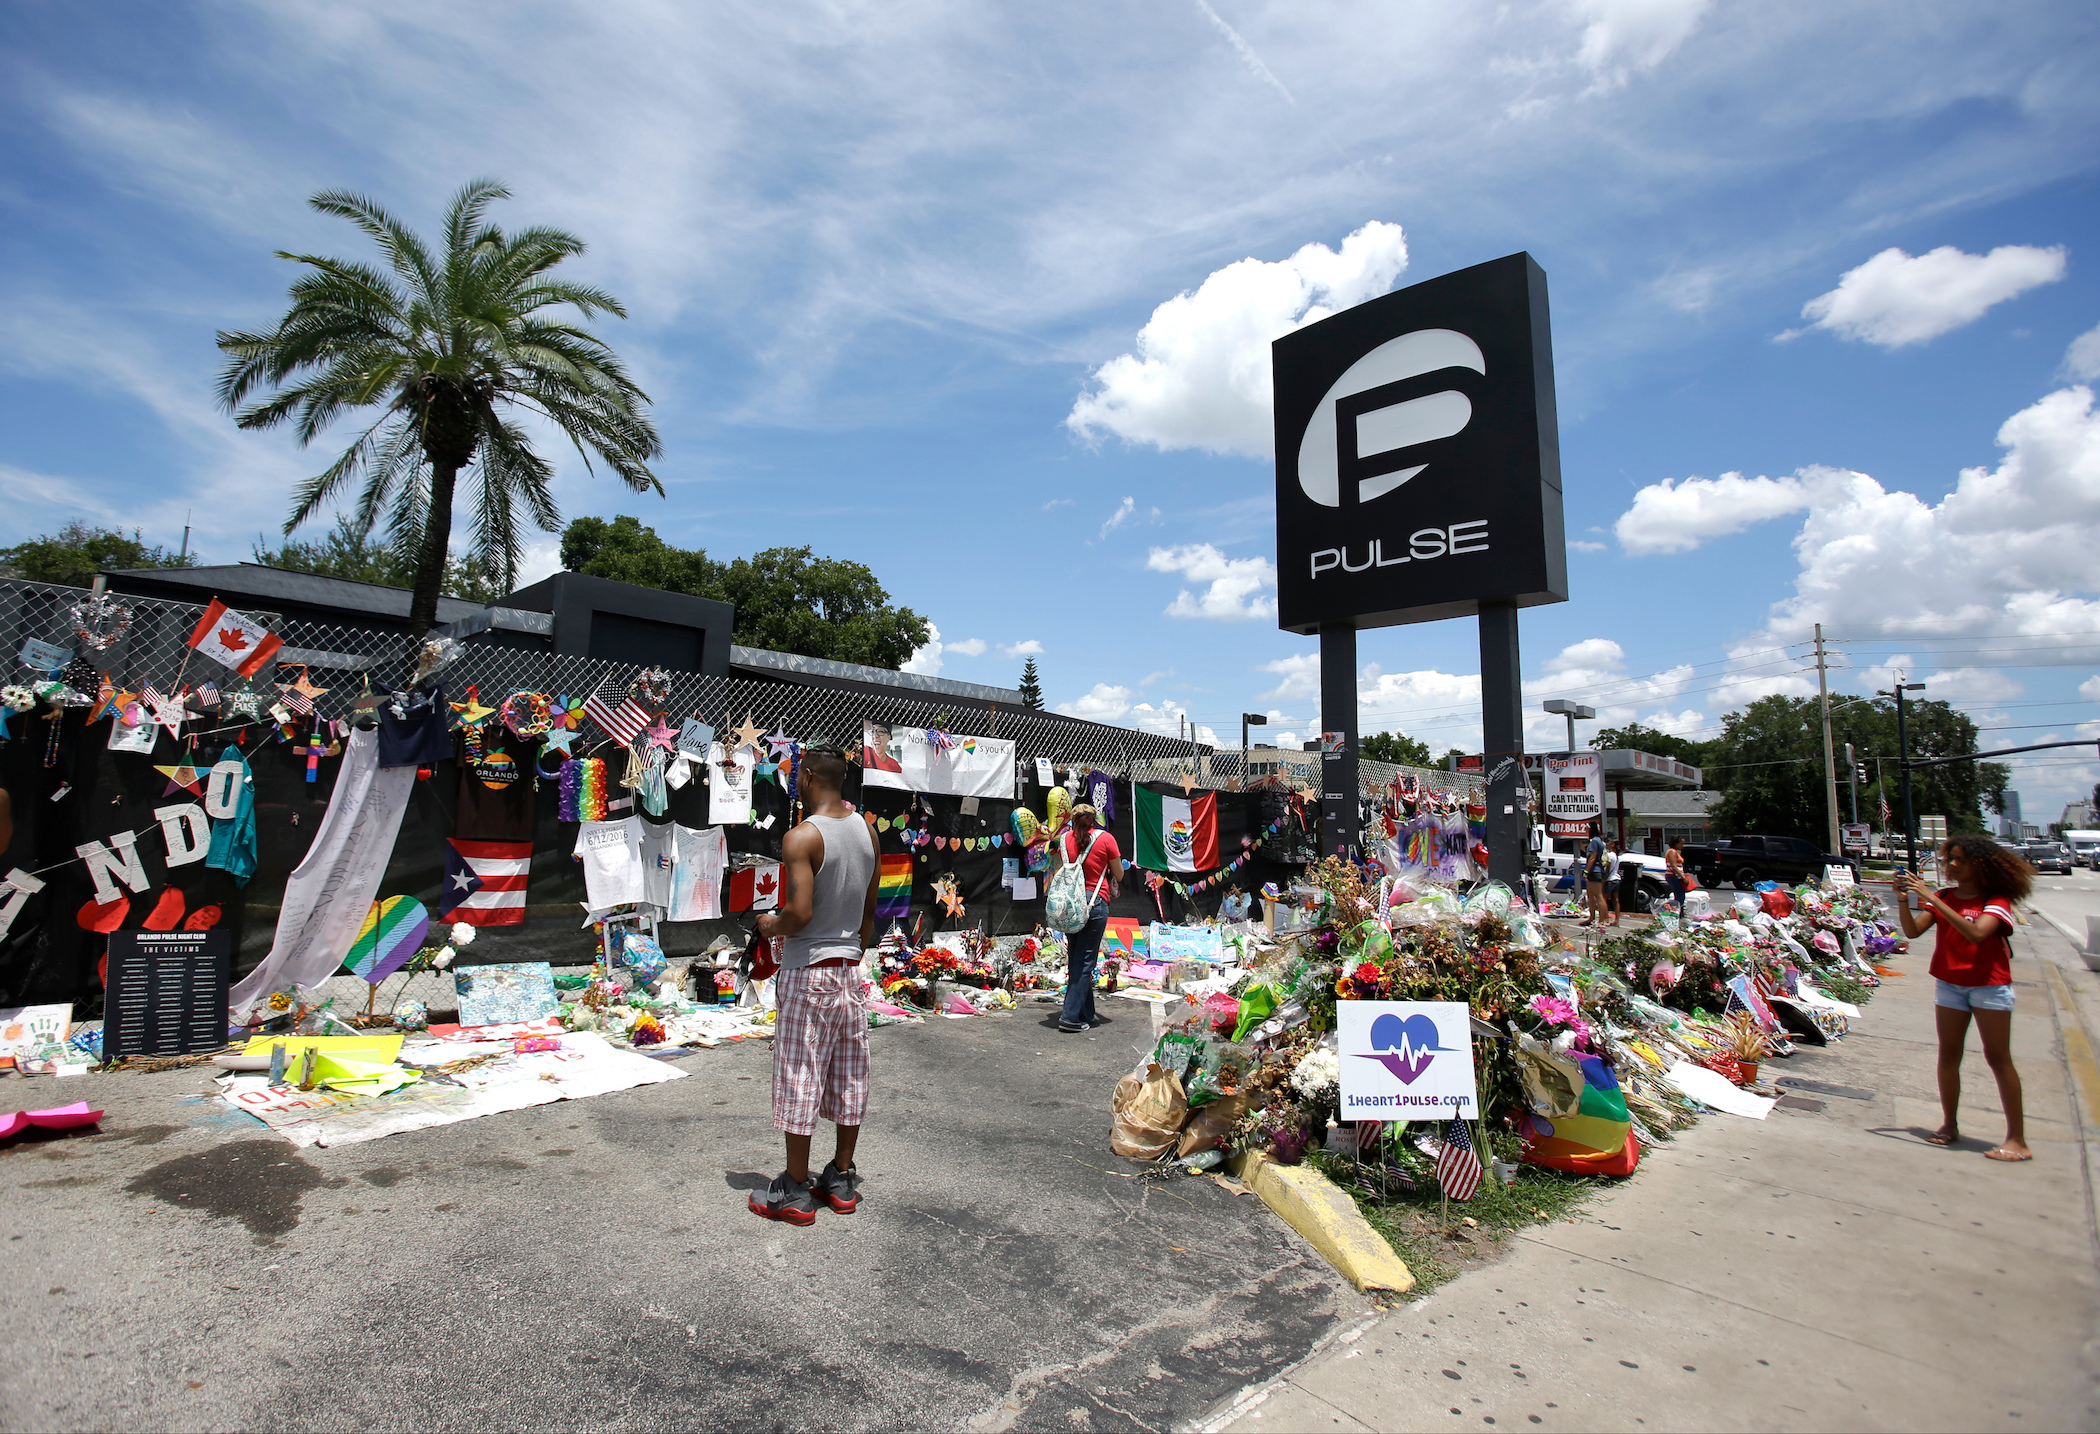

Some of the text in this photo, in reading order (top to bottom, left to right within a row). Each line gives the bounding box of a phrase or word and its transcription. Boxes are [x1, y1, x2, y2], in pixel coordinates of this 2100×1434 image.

[1311, 519, 1489, 579] PULSE
[224, 612, 255, 630] CANADA
[234, 692, 256, 702] ONE
[232, 702, 258, 712] PULSE
[160, 710, 180, 722] Pulse
[552, 729, 566, 738] Keep
[680, 724, 708, 753] love
[552, 734, 573, 746] Dancing
[985, 746, 999, 755] you
[1460, 756, 1481, 767] 3M
[1549, 760, 1569, 769] Pro
[1572, 756, 1594, 766] Tint
[476, 769, 519, 780] ORLANDO
[1564, 777, 1585, 787] 3M
[1551, 794, 1595, 803] CAR TINTING
[1548, 804, 1599, 813] CAR DETAILING
[586, 824, 627, 836] NEVER FORGET
[588, 830, 629, 846] 6/12/2016
[589, 842, 613, 851] ORLANDO
[136, 933, 161, 941] ORLANDO
[163, 945, 200, 953] VICTIMS
